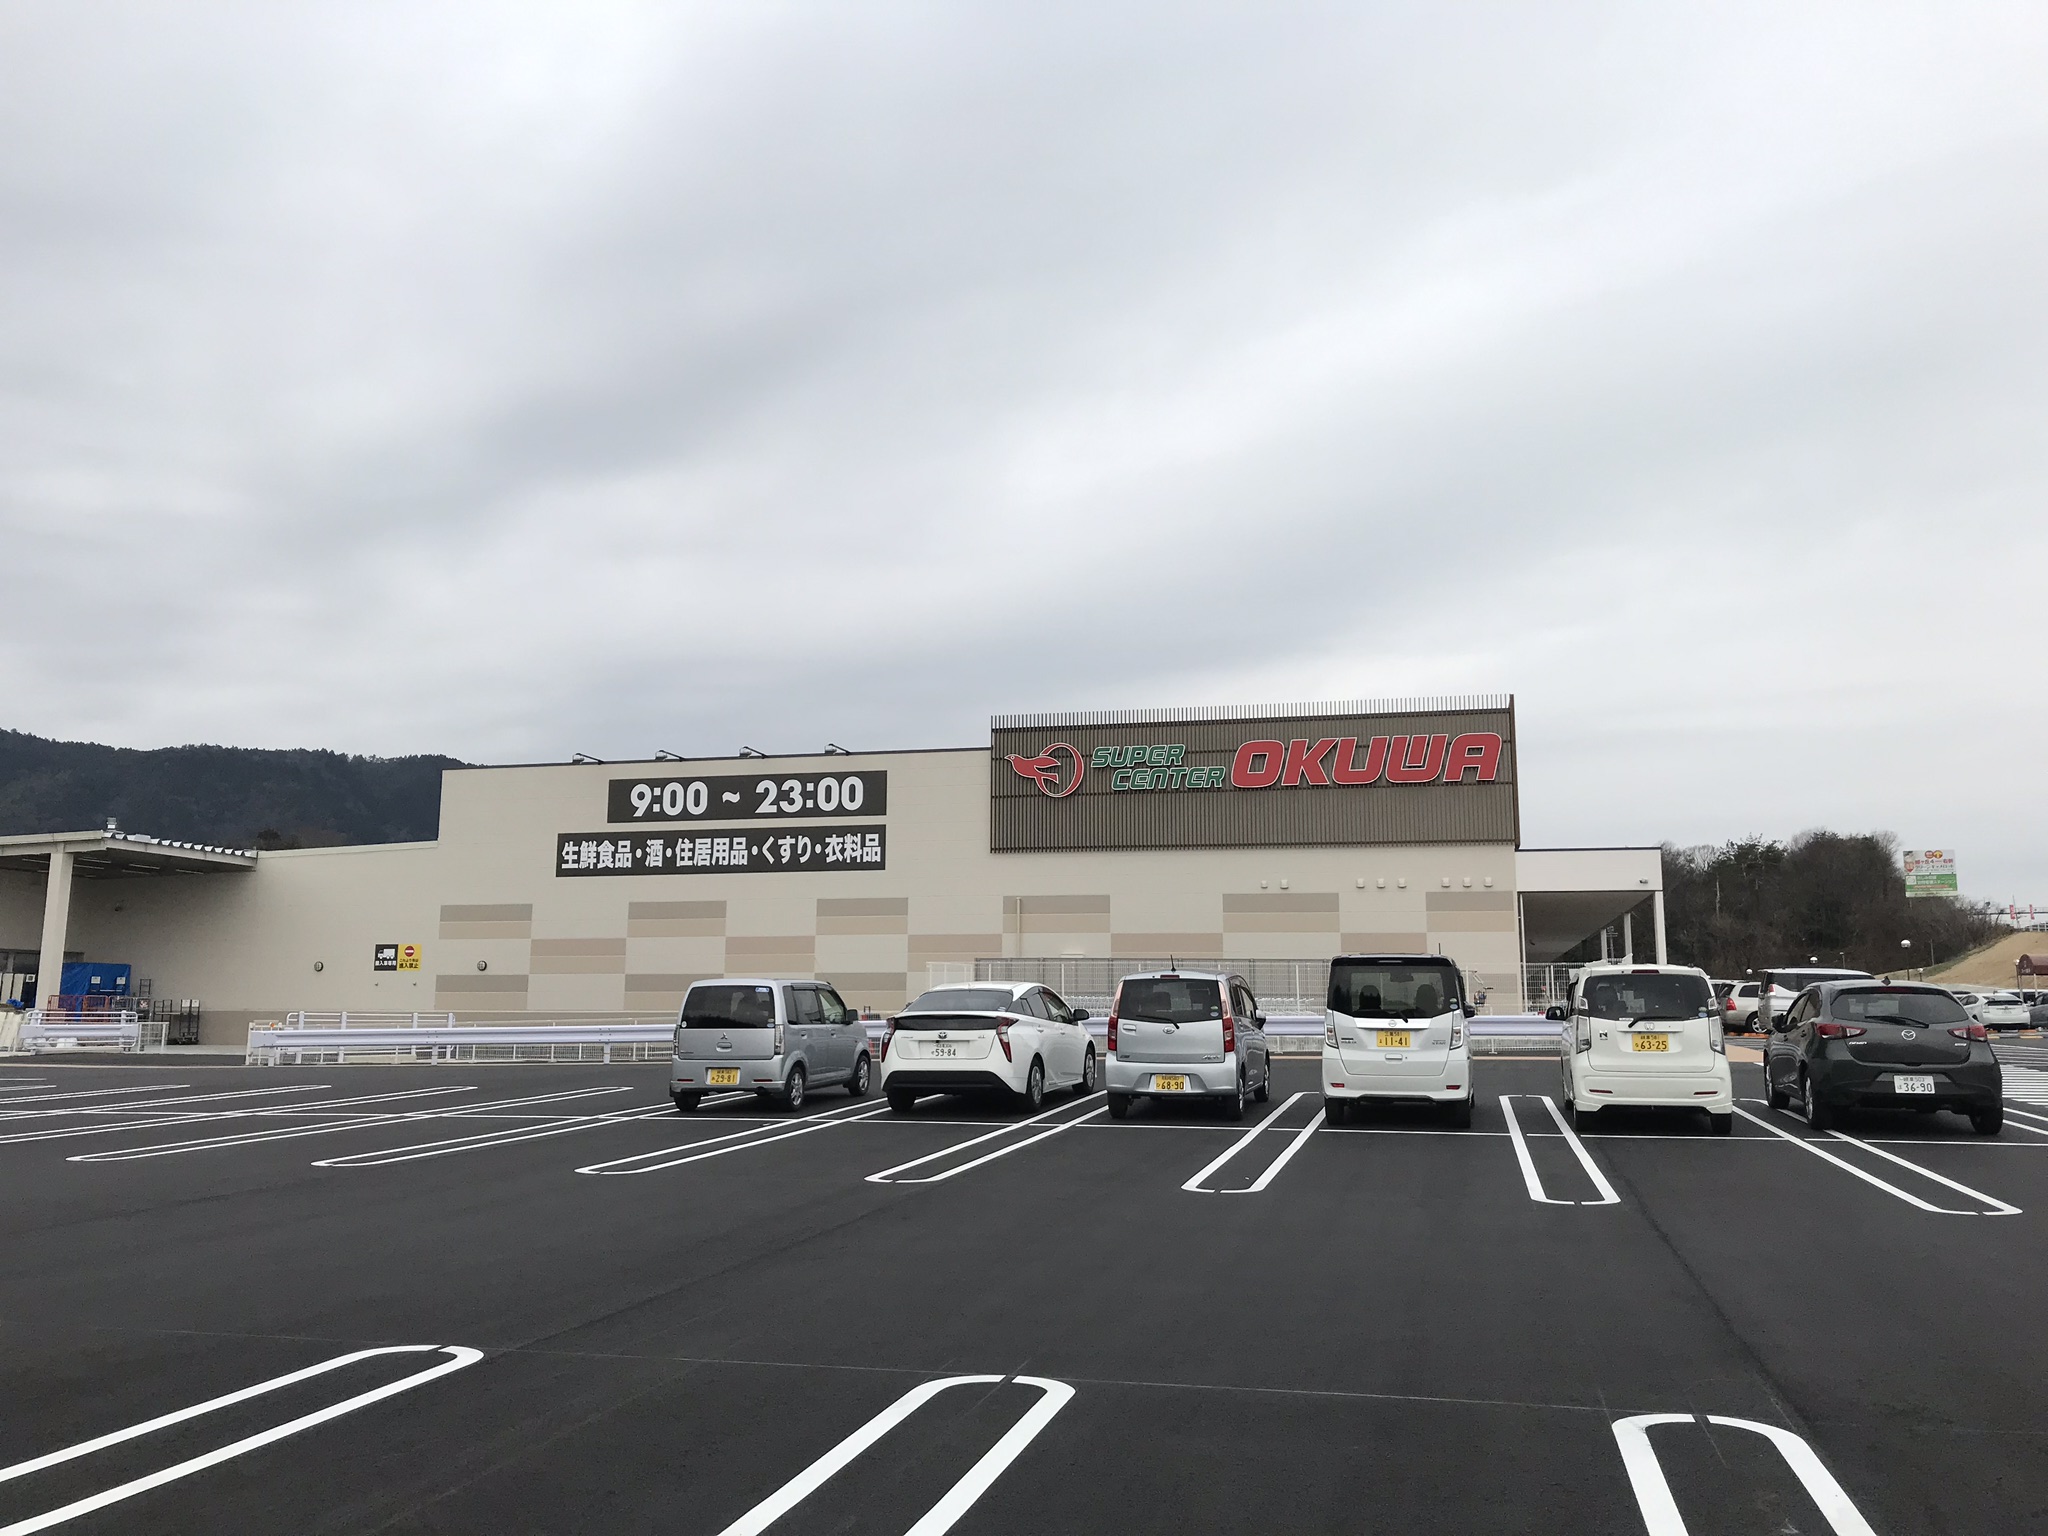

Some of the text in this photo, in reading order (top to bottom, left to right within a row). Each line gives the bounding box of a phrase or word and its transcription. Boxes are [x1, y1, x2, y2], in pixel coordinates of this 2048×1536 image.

[1090, 743, 1186, 768] SUPER
[1230, 732, 1503, 788] OKUWA
[1110, 764, 1226, 791] CENTER
[629, 780, 709, 817] 9:00
[754, 775, 865, 814] 23:00
[560, 832, 882, 870] 生鮮食品・酒・住居用品・くすり・衣料品
[1385, 1037, 1408, 1046] 11-41
[1640, 1040, 1667, 1050] 63-25
[935, 1048, 957, 1057] 59-84
[715, 1074, 735, 1083] 29-81
[1161, 1081, 1185, 1090] 68-90
[1903, 1083, 1933, 1093] 36-90
